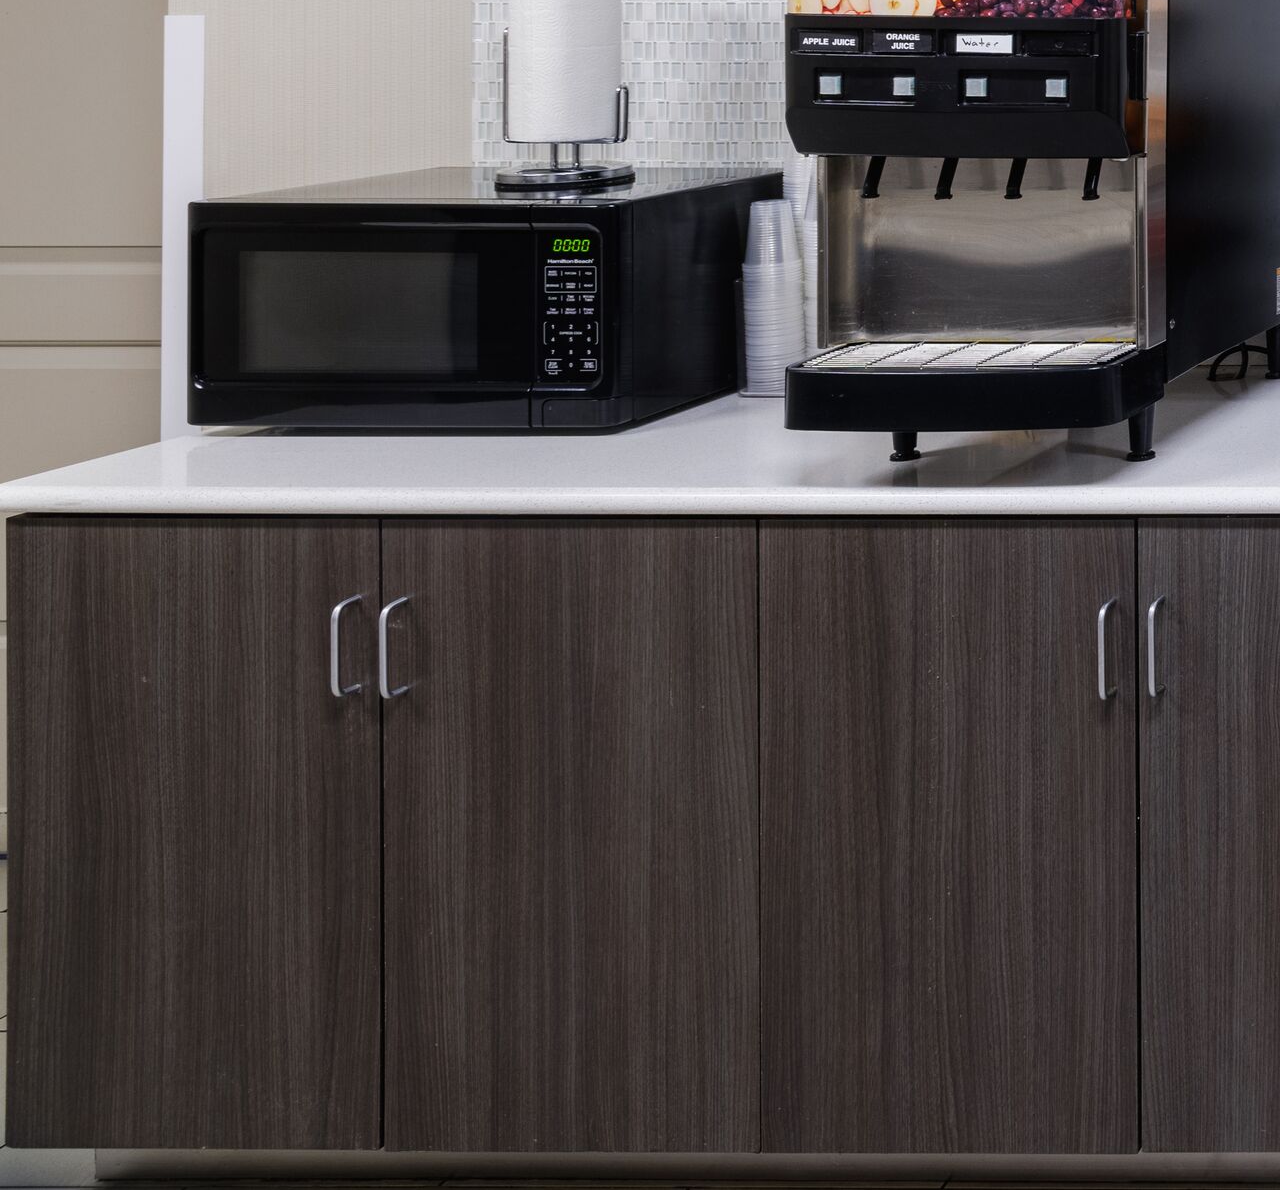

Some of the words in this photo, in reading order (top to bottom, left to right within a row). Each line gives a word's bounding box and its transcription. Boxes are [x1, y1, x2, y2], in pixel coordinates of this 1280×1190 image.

[885, 33, 921, 41] ORANGE
[802, 37, 829, 45] APPLE
[832, 38, 856, 46] JUICE
[891, 42, 915, 50] JUICE
